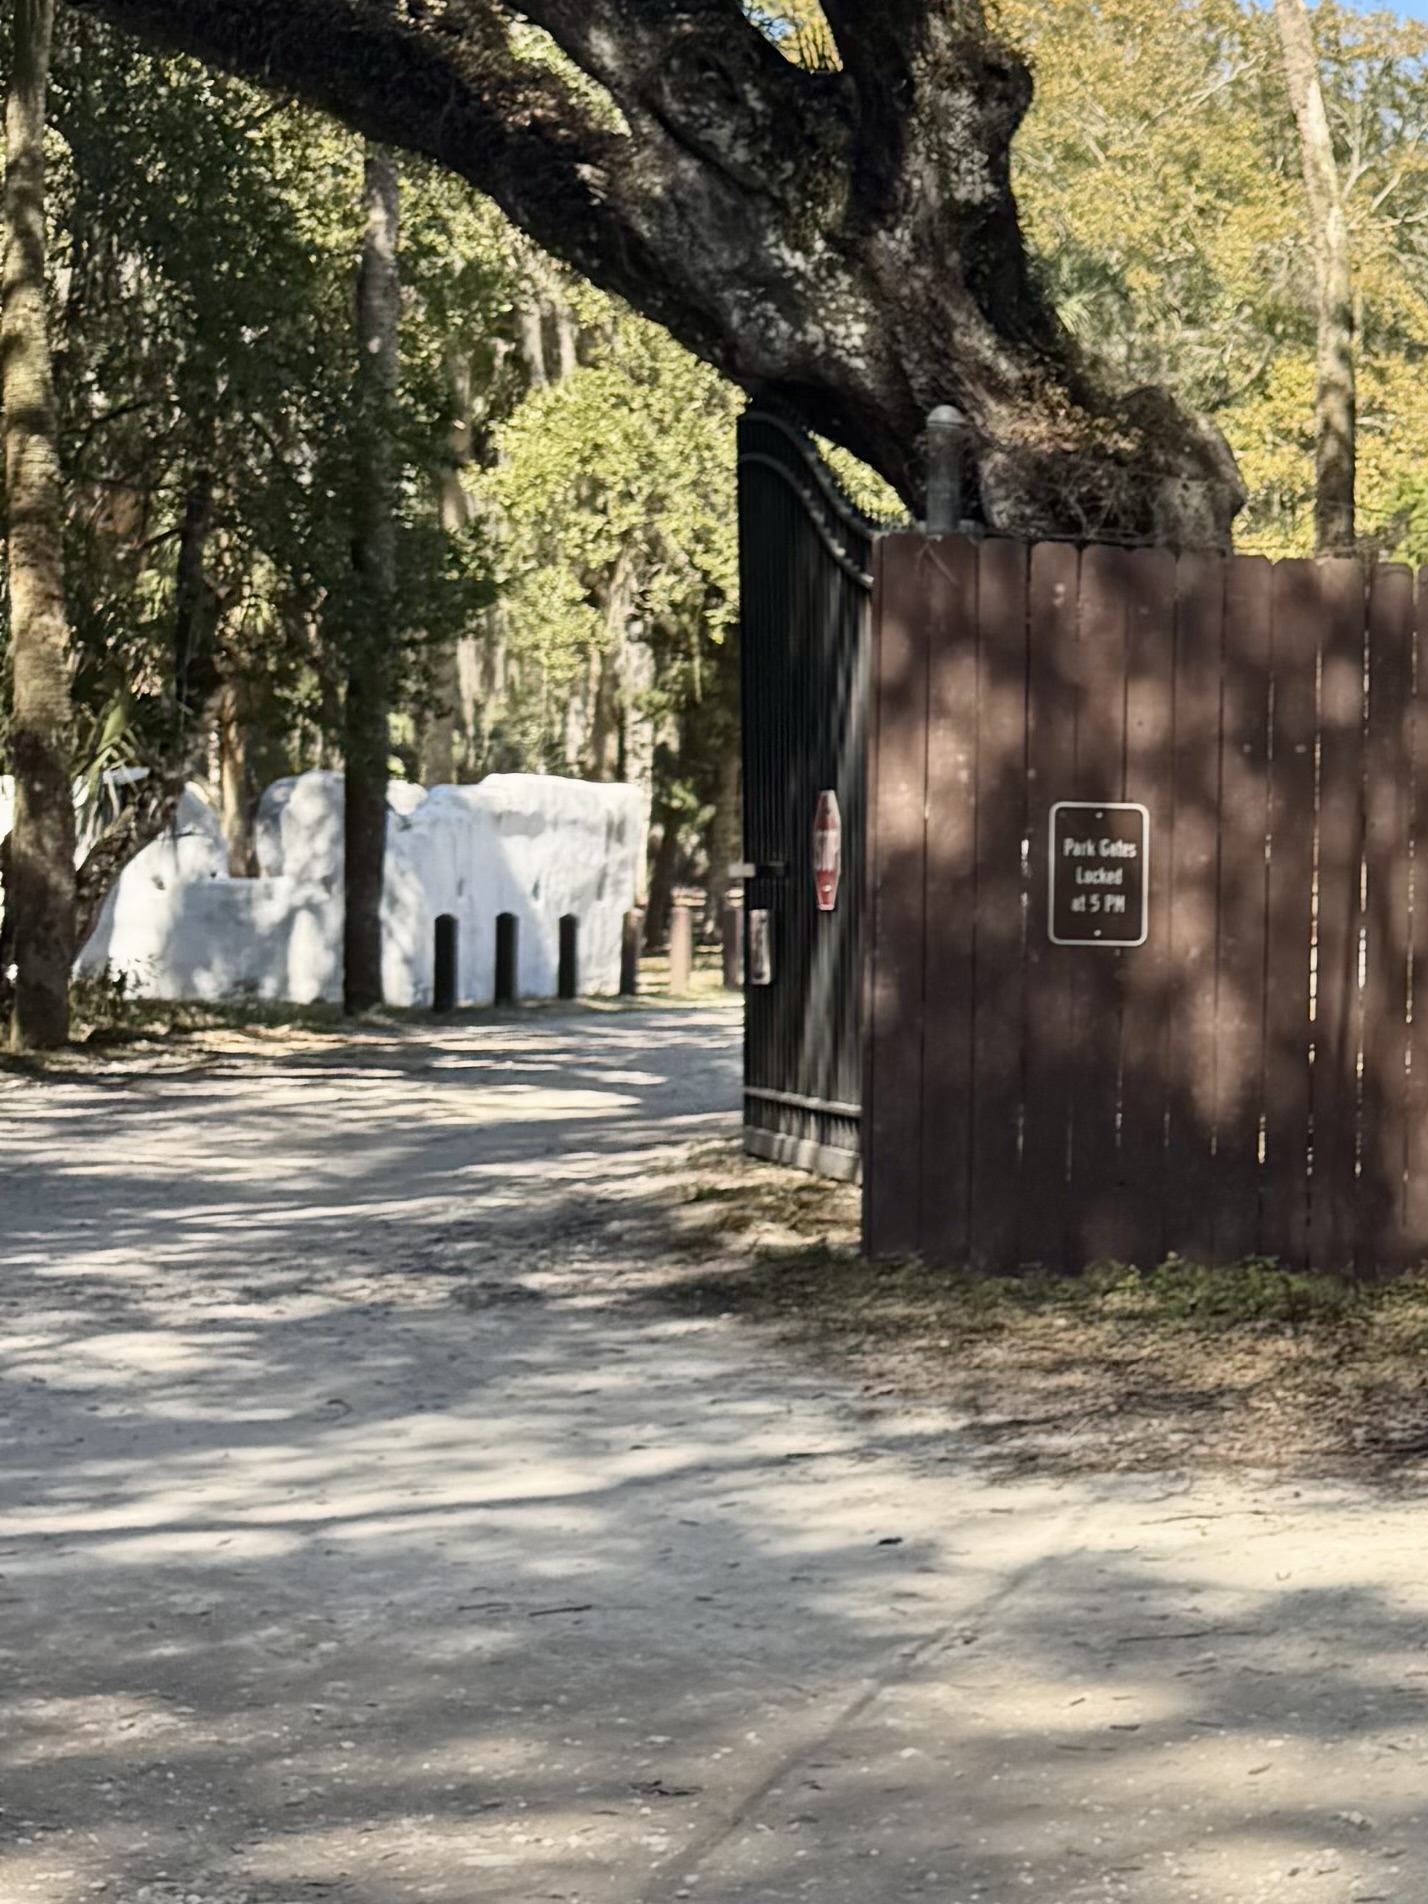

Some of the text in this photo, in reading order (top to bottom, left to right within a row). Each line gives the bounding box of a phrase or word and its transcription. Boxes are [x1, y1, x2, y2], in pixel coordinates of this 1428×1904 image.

[1063, 838, 1138, 859] Park Gates
[1075, 866, 1123, 886] Locked
[1070, 894, 1126, 913] at 5 PM
